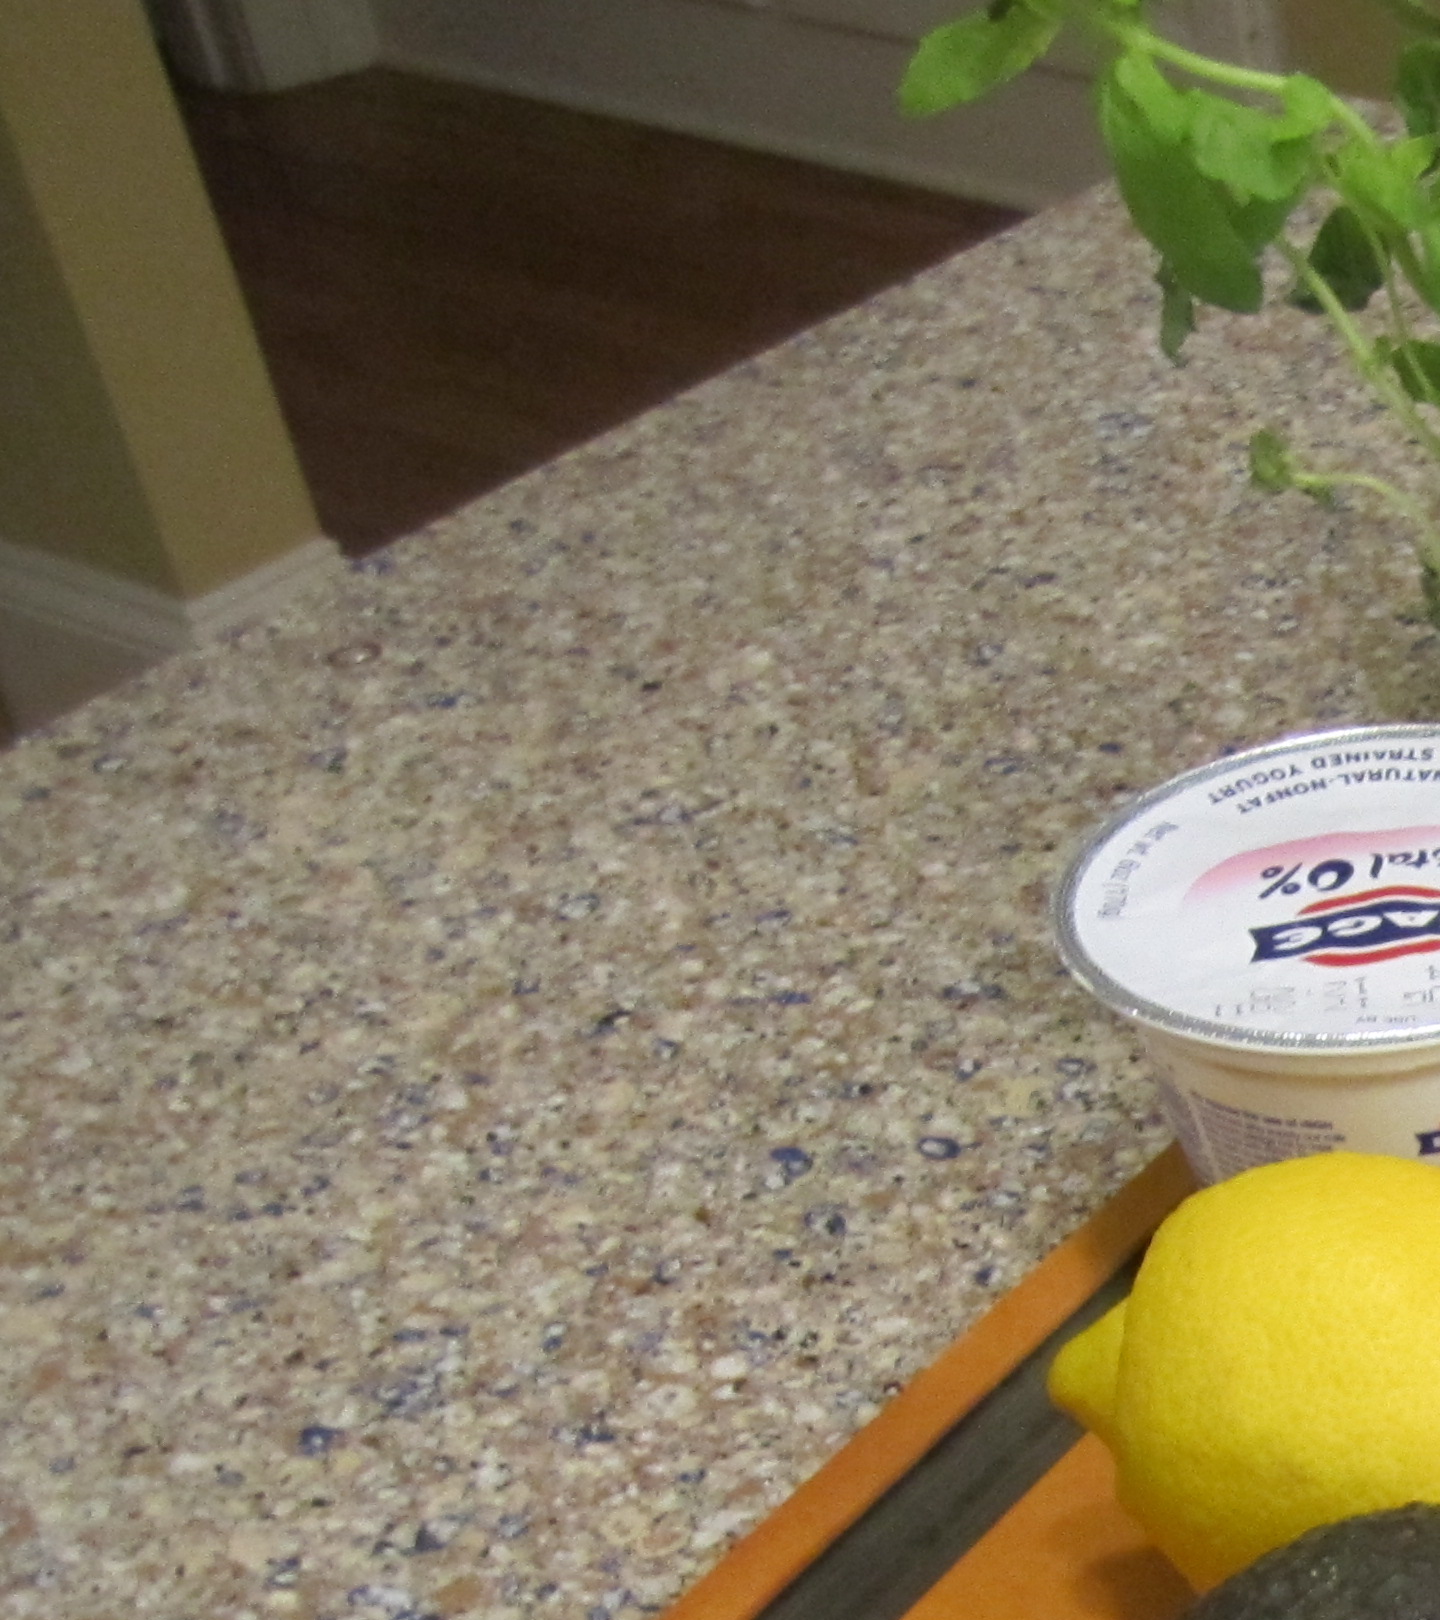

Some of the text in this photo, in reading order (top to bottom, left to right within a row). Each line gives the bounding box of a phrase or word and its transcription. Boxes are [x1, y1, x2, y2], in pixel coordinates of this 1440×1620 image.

[1310, 747, 1434, 769] STRAINED
[1207, 764, 1302, 805] YOGURT
[1257, 859, 1355, 900] 0%
